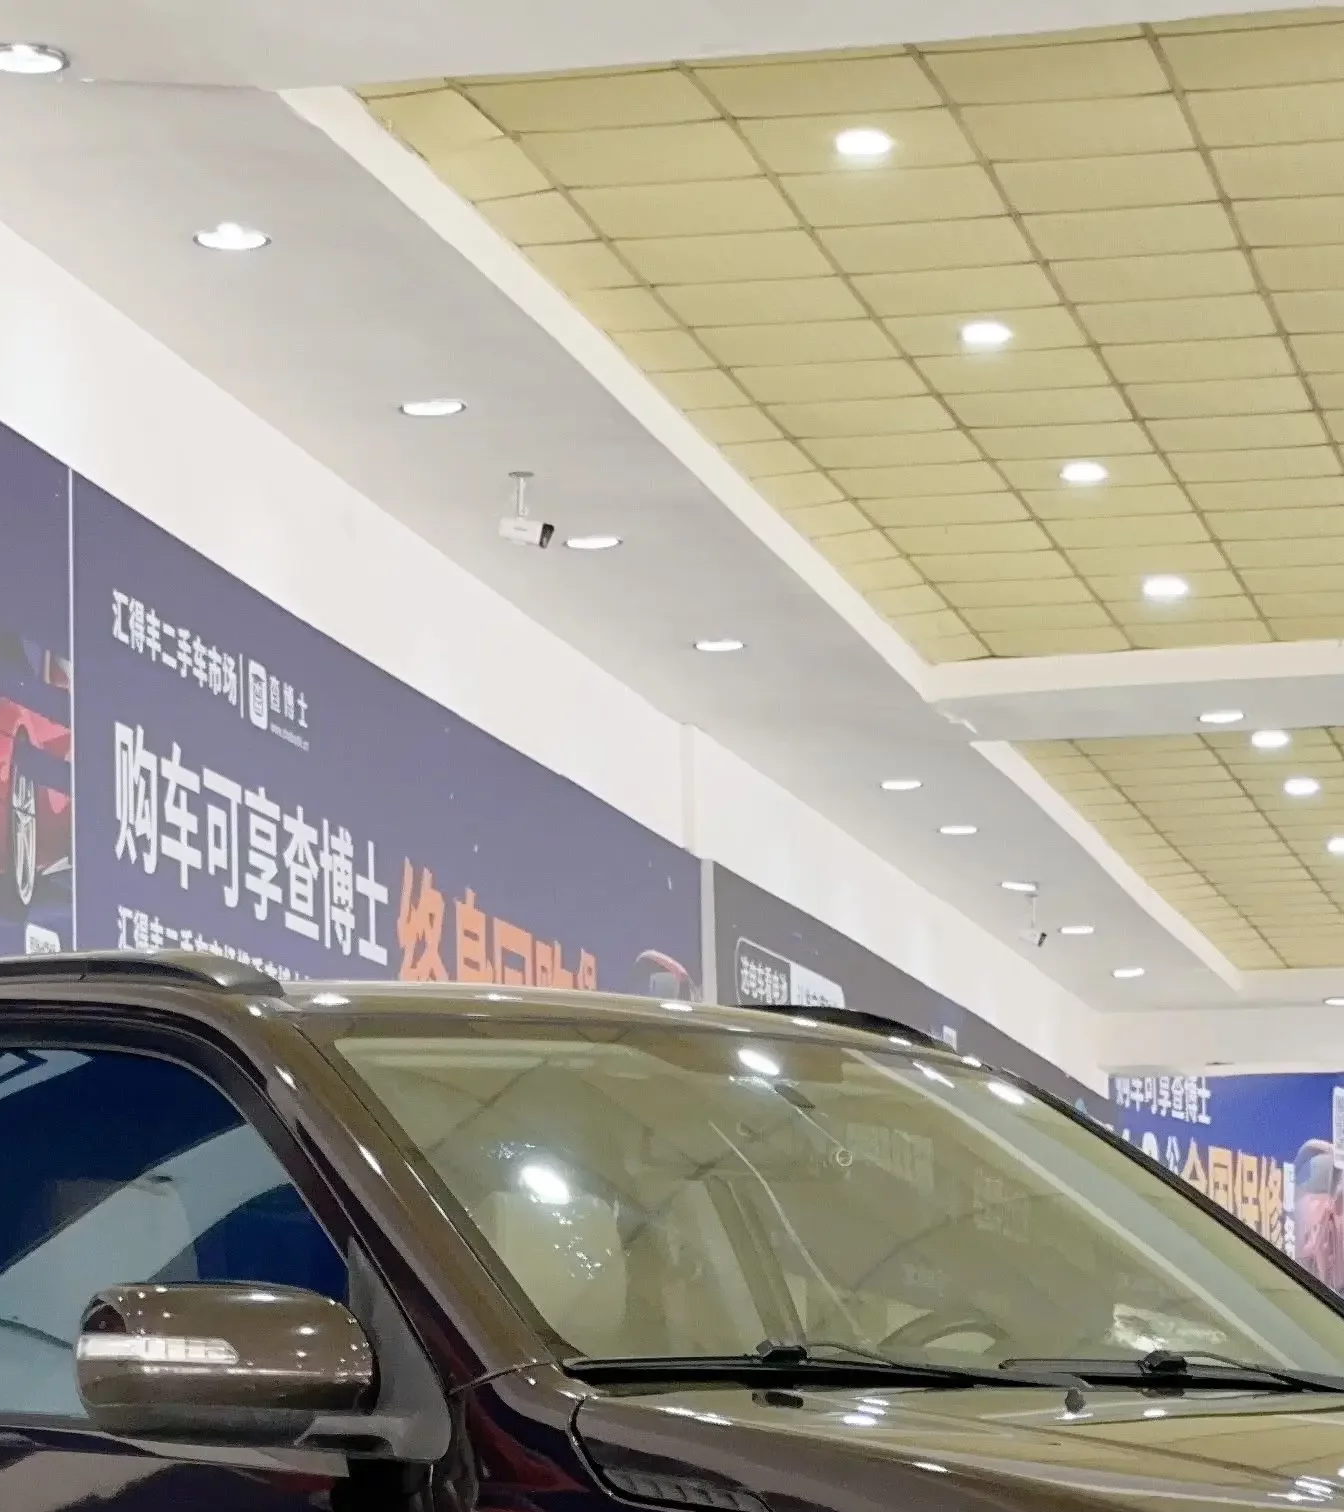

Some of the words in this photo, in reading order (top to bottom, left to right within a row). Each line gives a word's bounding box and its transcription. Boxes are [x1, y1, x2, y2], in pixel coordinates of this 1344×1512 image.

[112, 588, 237, 706] 汇得丰二手车市场
[114, 720, 389, 966] 购车可享查博士
